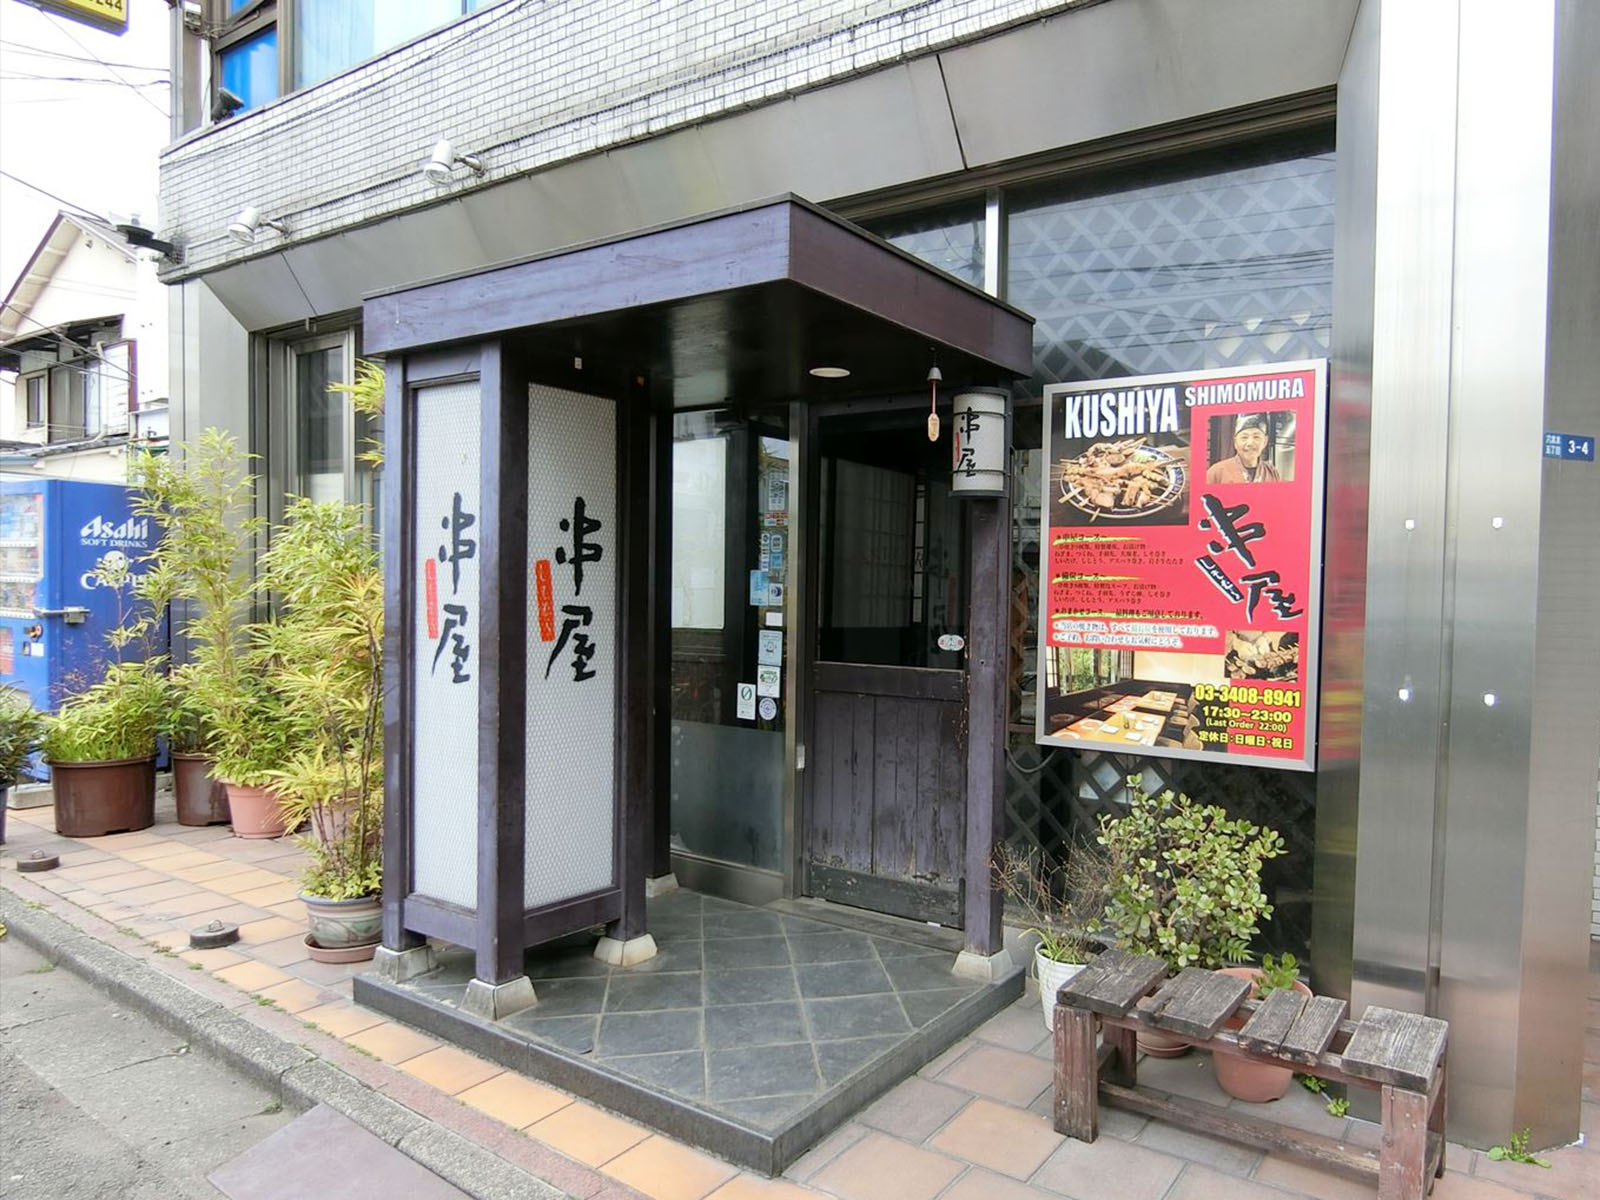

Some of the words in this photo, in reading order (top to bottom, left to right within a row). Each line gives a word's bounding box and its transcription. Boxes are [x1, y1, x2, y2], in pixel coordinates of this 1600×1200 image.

[1064, 386, 1179, 439] KUSHIYA
[1184, 377, 1305, 408] SHIMOMURA
[956, 406, 980, 477] 串屋
[1568, 440, 1589, 455] 3-4
[80, 515, 149, 539] Asahi
[80, 537, 107, 546] SOFT
[109, 539, 149, 548] DRINKS
[1198, 493, 1304, 624] 串屋
[431, 492, 476, 684] 串屋
[544, 496, 604, 682] 串屋
[1194, 683, 1301, 707] 03-3408-8941
[1228, 719, 1255, 729] Order
